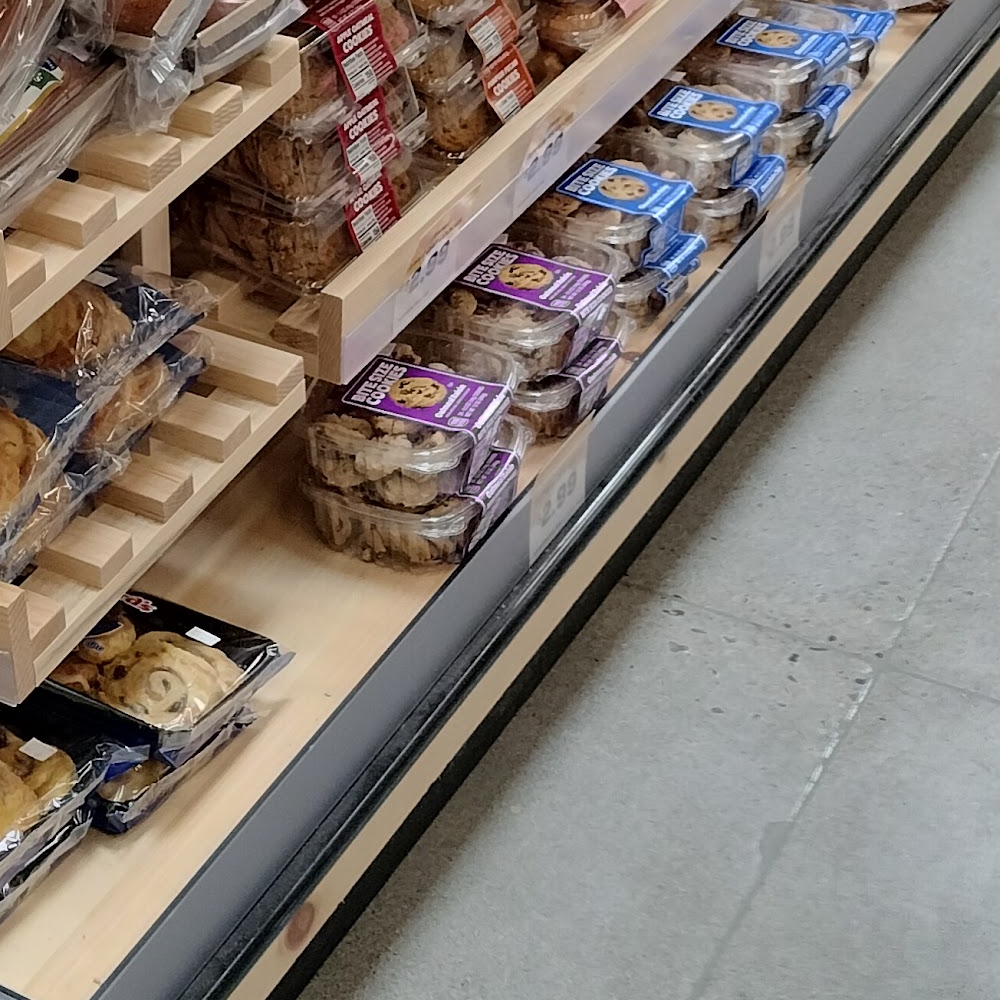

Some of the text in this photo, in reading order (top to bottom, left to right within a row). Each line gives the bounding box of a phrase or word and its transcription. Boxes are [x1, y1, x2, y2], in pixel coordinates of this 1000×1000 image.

[342, 24, 374, 54] COOKIES
[492, 68, 521, 97] COOKIES
[348, 108, 378, 140] COOKIES
[353, 180, 383, 212] COOKIES
[564, 176, 584, 193] BITE
[577, 165, 618, 196] COOKIES
[463, 249, 504, 283] BITE SIZE
[475, 252, 519, 286] COOKIES
[350, 361, 393, 403] BITE SIZE
[365, 366, 409, 406] COOKIES
